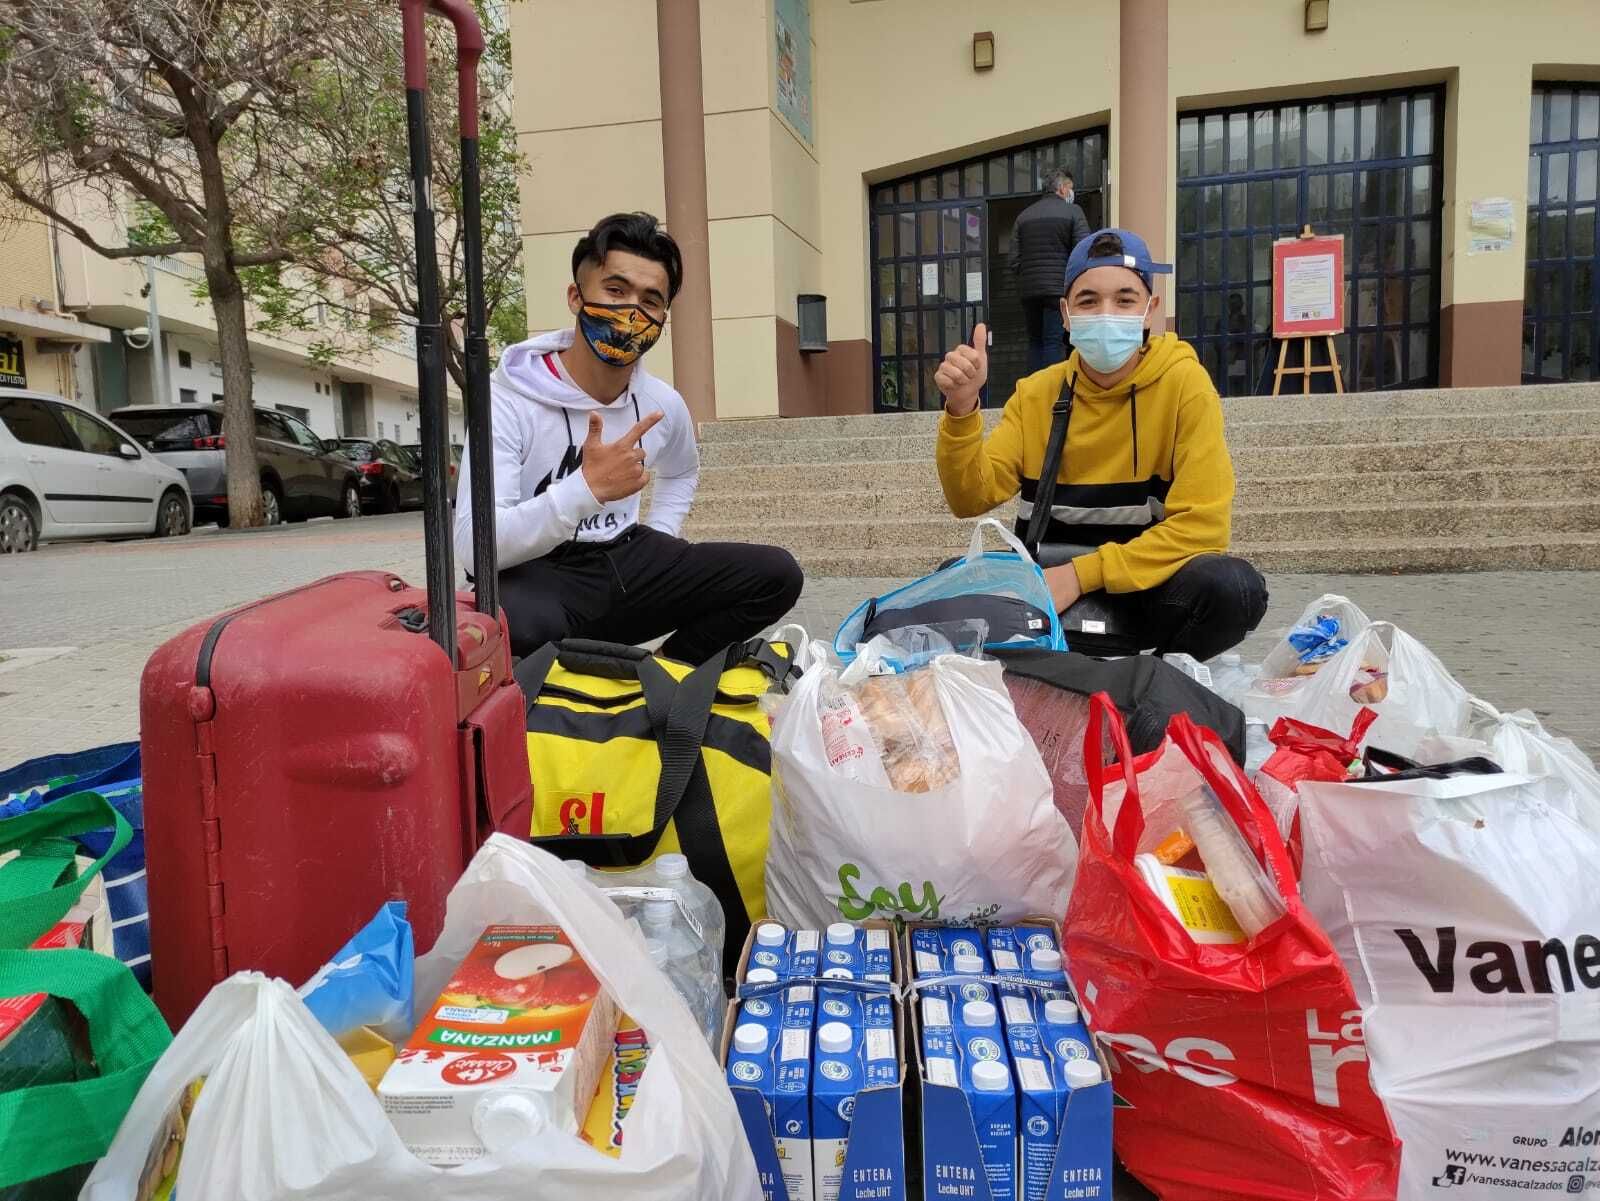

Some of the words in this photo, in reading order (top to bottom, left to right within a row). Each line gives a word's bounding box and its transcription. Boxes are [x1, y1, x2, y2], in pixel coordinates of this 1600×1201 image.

[440, 1029, 554, 1046] MANZANA
[1512, 1136, 1548, 1148] GRUPO
[1446, 1148, 1600, 1173] www.vanessacalz
[853, 1167, 892, 1183] ENTERA
[935, 1164, 976, 1182] ENTERA
[1063, 1167, 1102, 1183] ENTERA
[938, 1182, 958, 1195] Leche
[959, 1184, 975, 1197] UHT
[1466, 1173, 1563, 1190] /vanessacalzados
[855, 1187, 875, 1199] Leche
[876, 1186, 891, 1198] UHT
[1064, 1187, 1084, 1199] Leche
[1085, 1185, 1100, 1197] UHT
